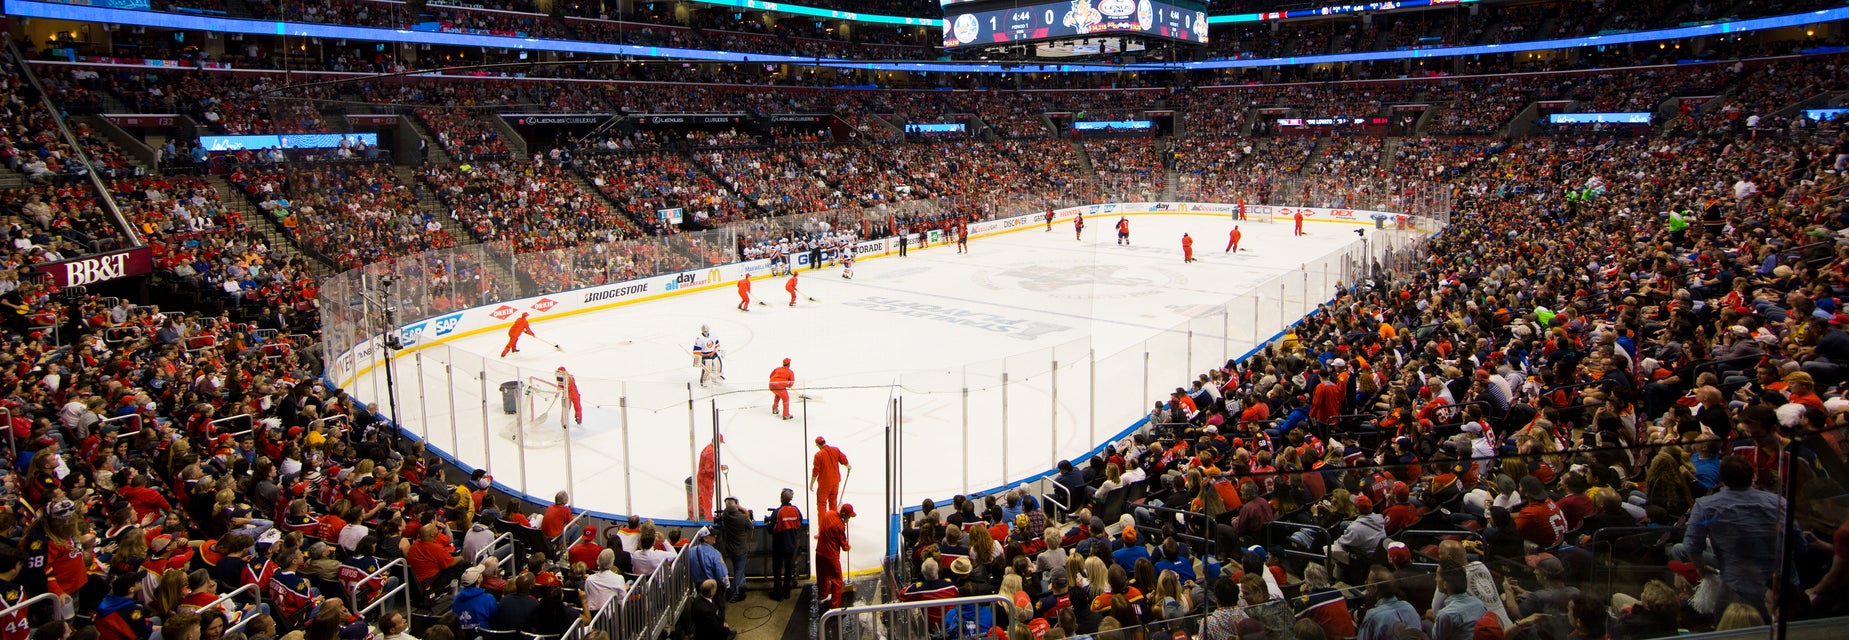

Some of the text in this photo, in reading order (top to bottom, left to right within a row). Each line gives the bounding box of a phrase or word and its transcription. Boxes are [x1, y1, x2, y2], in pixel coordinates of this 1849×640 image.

[989, 16, 996, 31] 1
[1012, 11, 1030, 21] 4:44
[1045, 9, 1054, 25] 0
[1185, 14, 1190, 29] 0
[1156, 203, 1169, 211] day
[1003, 217, 1026, 228] DISCOVER
[64, 252, 130, 287] BB&T
[665, 280, 678, 291] all
[677, 273, 696, 284] day
[584, 283, 649, 303] BRIDGESTONE
[533, 301, 554, 309] ORKIN
[493, 309, 514, 317] ORKIN
[437, 317, 458, 334] SAP
[402, 327, 422, 344] SAP
[5, 617, 29, 634] 44
